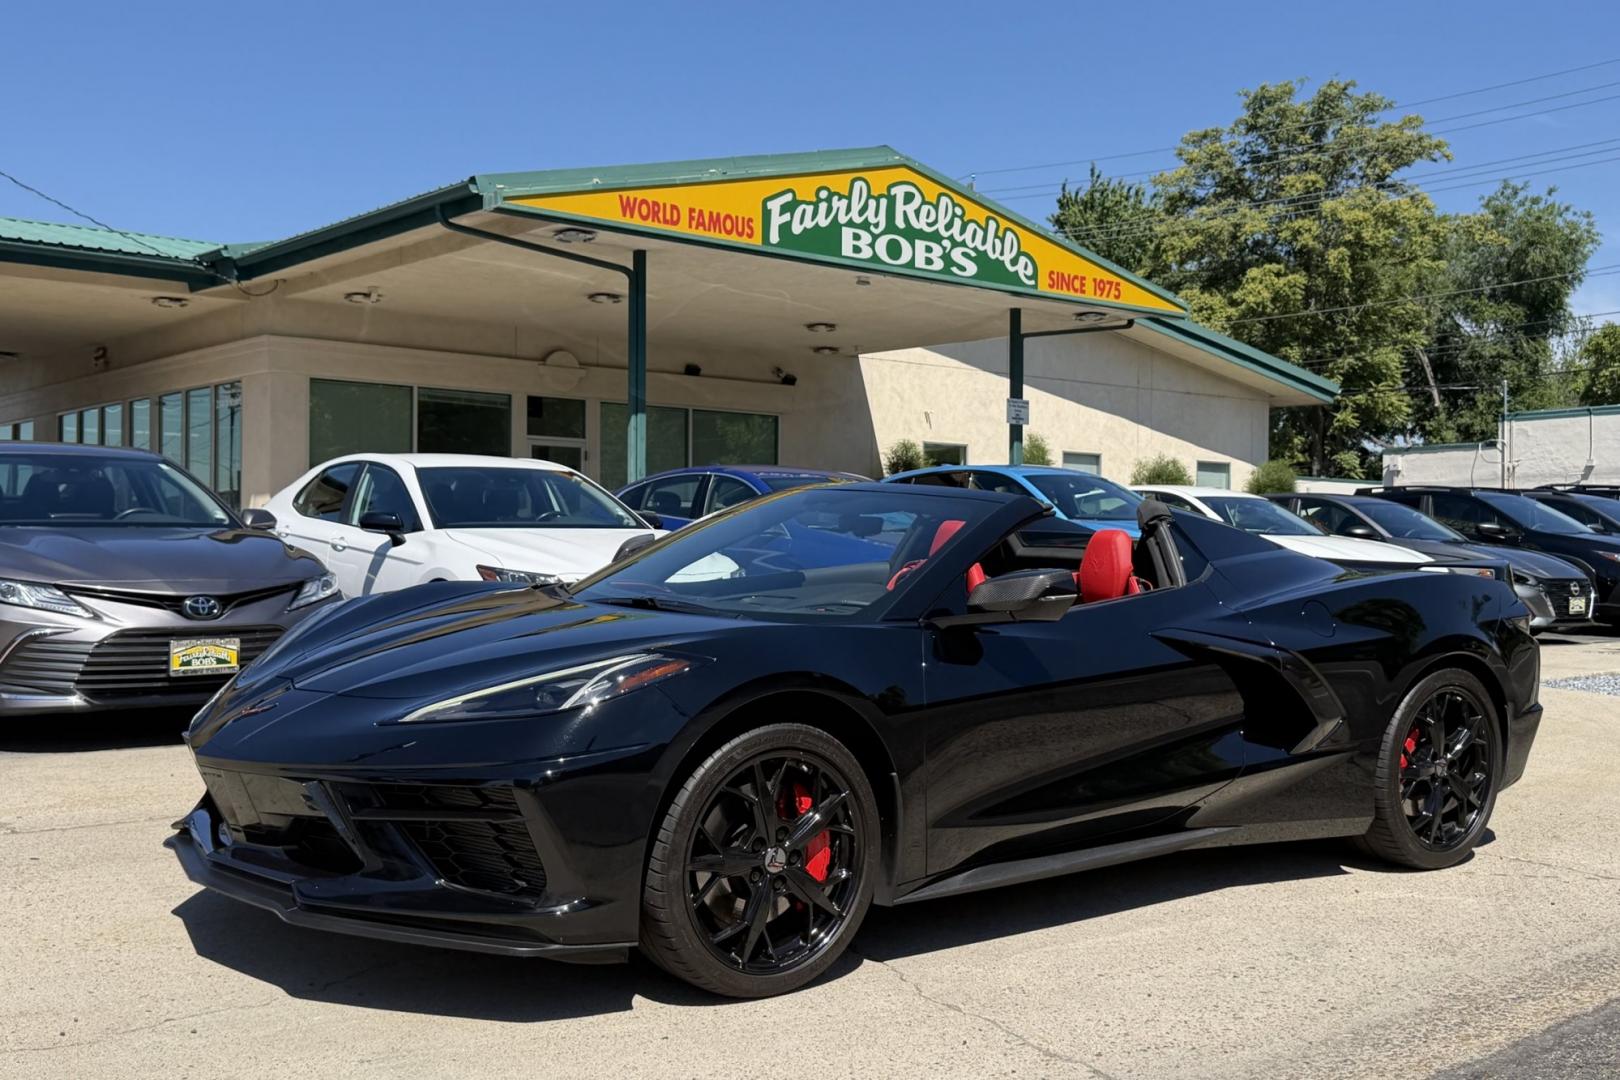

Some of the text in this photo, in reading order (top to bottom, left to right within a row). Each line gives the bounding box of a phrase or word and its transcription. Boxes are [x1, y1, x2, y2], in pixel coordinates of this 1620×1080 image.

[618, 194, 754, 239] WORLD FAMOUS
[766, 180, 1035, 285] Fairly Reliable
[841, 226, 978, 277] BOB'S
[1048, 270, 1121, 299] SINCE 1975
